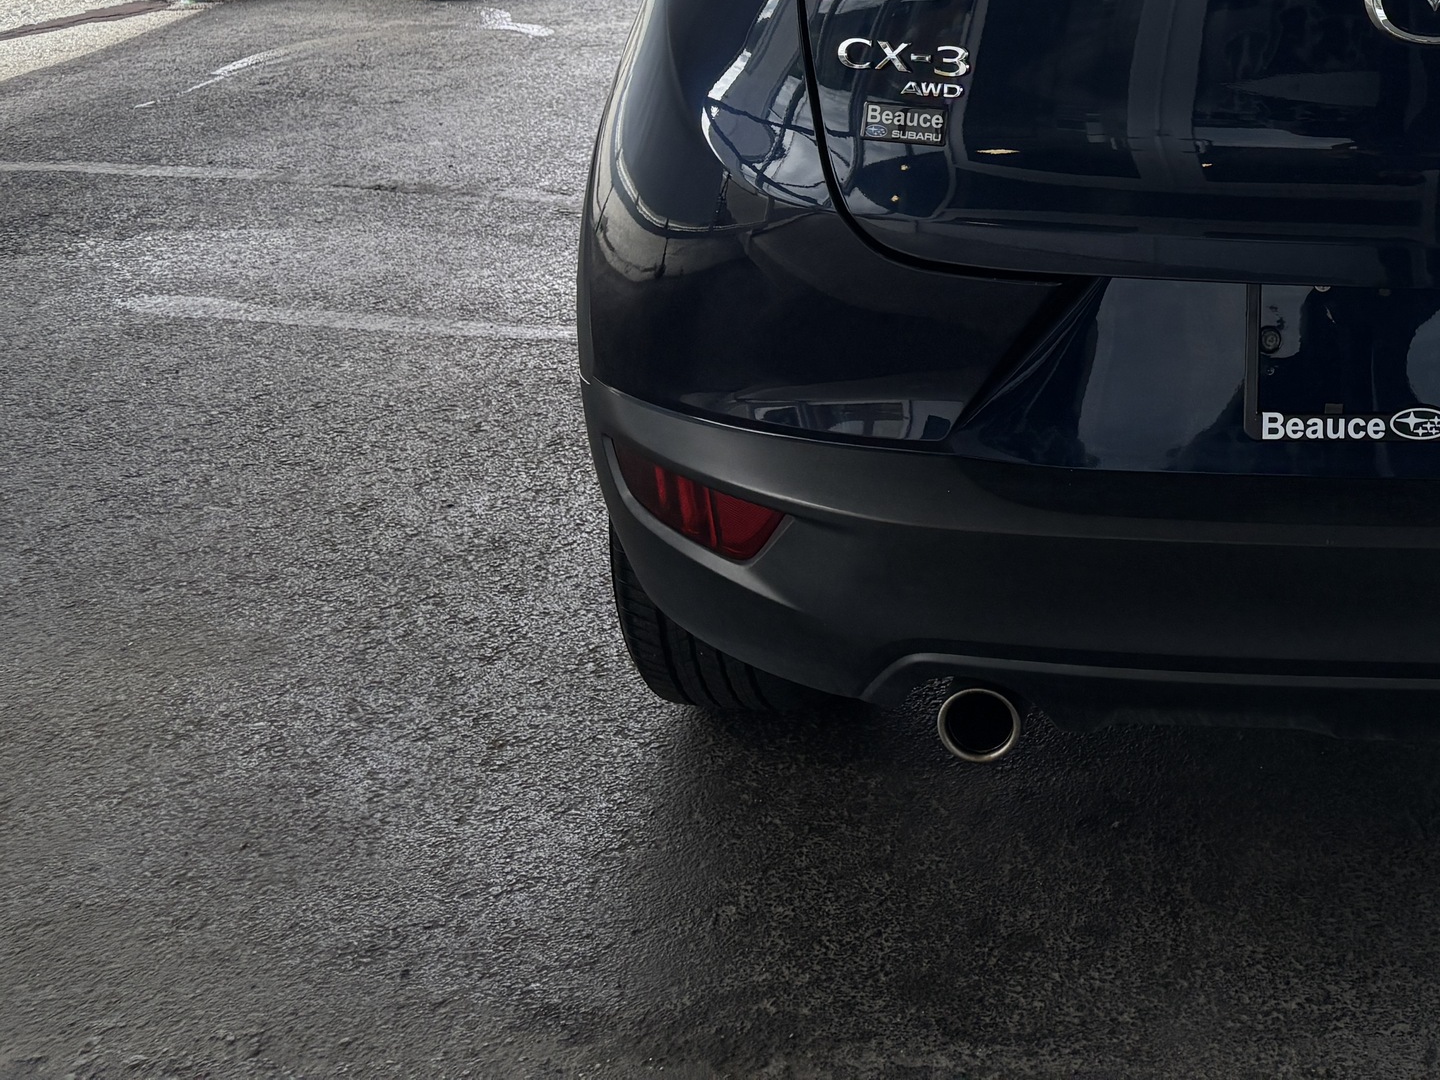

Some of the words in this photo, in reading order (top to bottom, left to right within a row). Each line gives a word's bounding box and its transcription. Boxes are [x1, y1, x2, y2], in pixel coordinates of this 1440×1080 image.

[837, 37, 971, 78] CX-3
[900, 80, 964, 99] AWD
[866, 104, 944, 129] Beauce
[891, 129, 942, 142] SUBARU
[1261, 411, 1387, 441] Beauce
